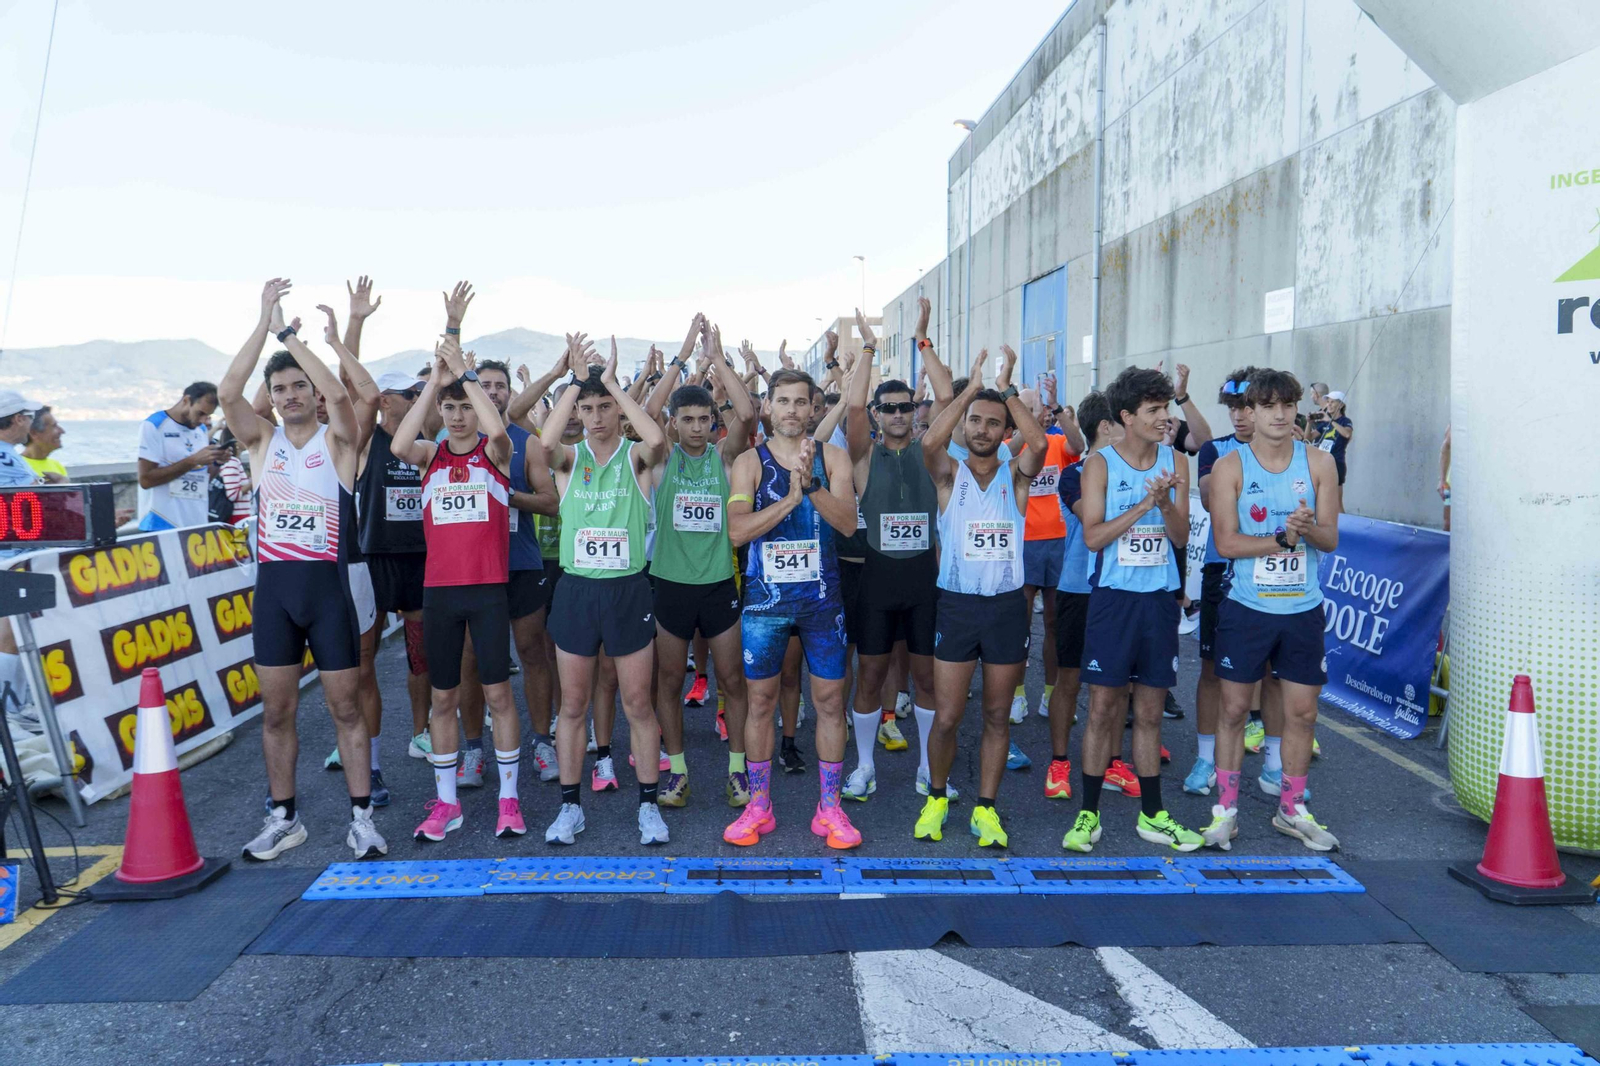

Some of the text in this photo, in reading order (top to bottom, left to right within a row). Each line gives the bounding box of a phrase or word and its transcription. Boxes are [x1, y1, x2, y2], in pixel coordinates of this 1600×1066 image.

[182, 481, 198, 492] 26
[574, 488, 630, 500] SAN MIGUEL
[396, 498, 422, 510] 601
[442, 495, 476, 511] 501
[0, 492, 43, 540] 0
[682, 506, 715, 520] 506
[276, 515, 316, 531] 524
[890, 525, 922, 539] 526
[974, 533, 1009, 548] 515
[1129, 538, 1162, 553] 507
[586, 541, 621, 556] 611
[68, 541, 161, 596] GADIS
[775, 553, 809, 570] 541
[1265, 557, 1299, 572] 510
[1326, 555, 1404, 614] Escoge
[112, 611, 194, 670] GADIS
[1345, 674, 1392, 704] Descúbrelos en
[118, 688, 205, 755] GDIS
[1394, 705, 1419, 726] Galicia
[497, 870, 657, 881] CRONOTEC
